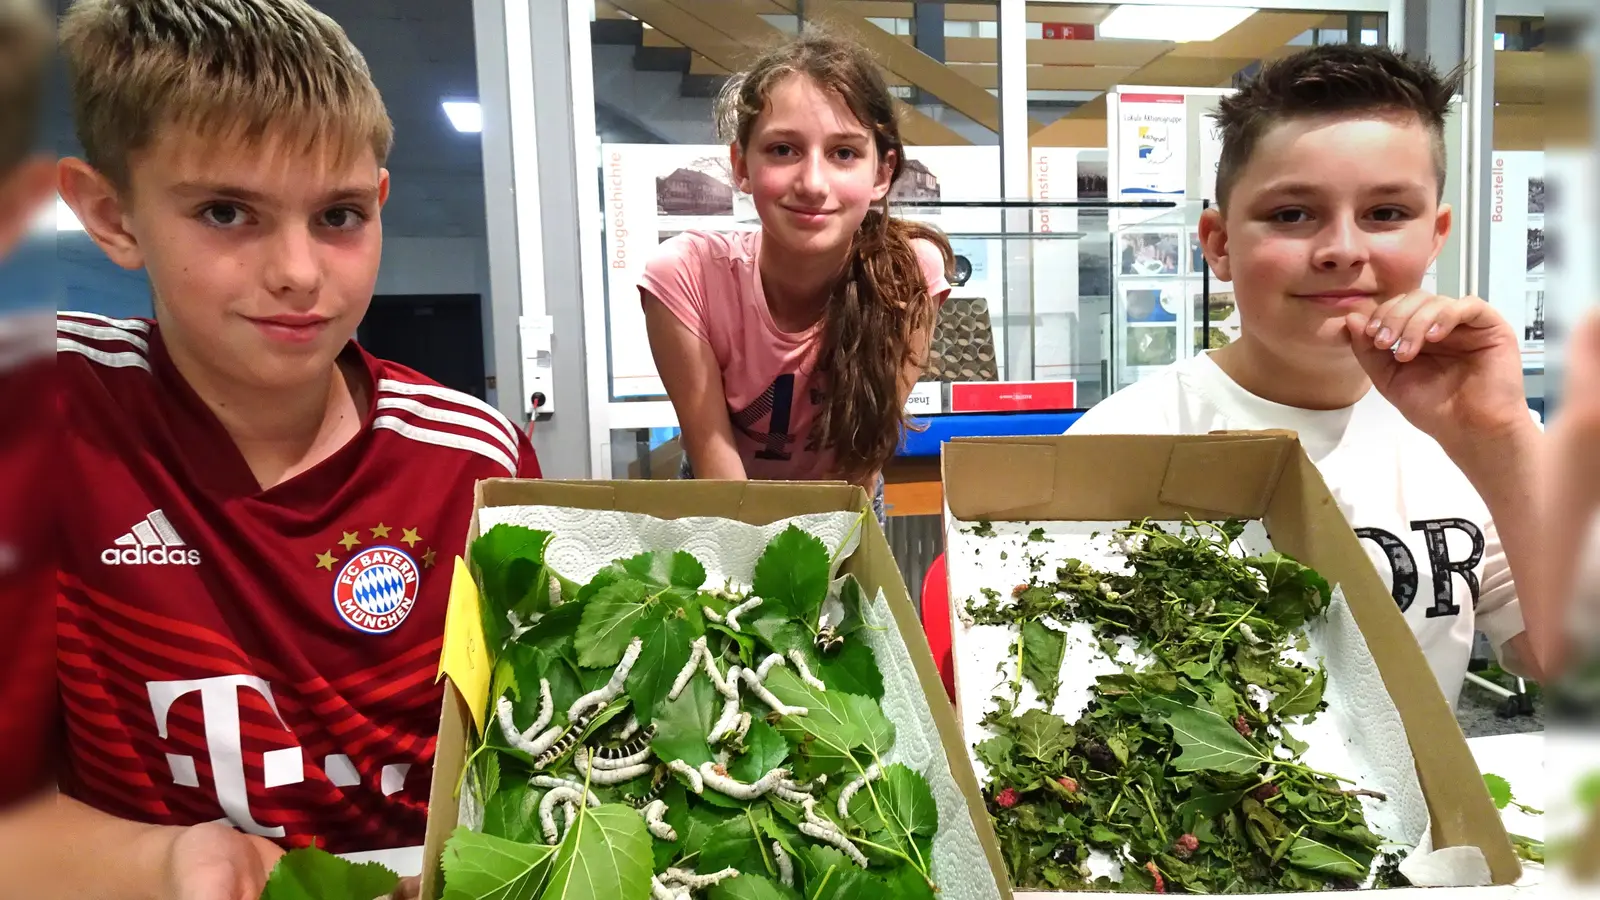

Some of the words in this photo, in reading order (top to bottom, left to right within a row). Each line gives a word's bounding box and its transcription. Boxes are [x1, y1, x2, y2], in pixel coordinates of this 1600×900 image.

[1035, 156, 1053, 241] patnstich
[1492, 158, 1504, 222] Baustelle
[609, 152, 628, 269] Baugeschichte
[908, 396, 930, 406] Inac
[101, 543, 202, 566] adidas
[341, 565, 360, 585] FC
[360, 551, 416, 584] BAYERN
[341, 597, 412, 629] MÜNCHEN
